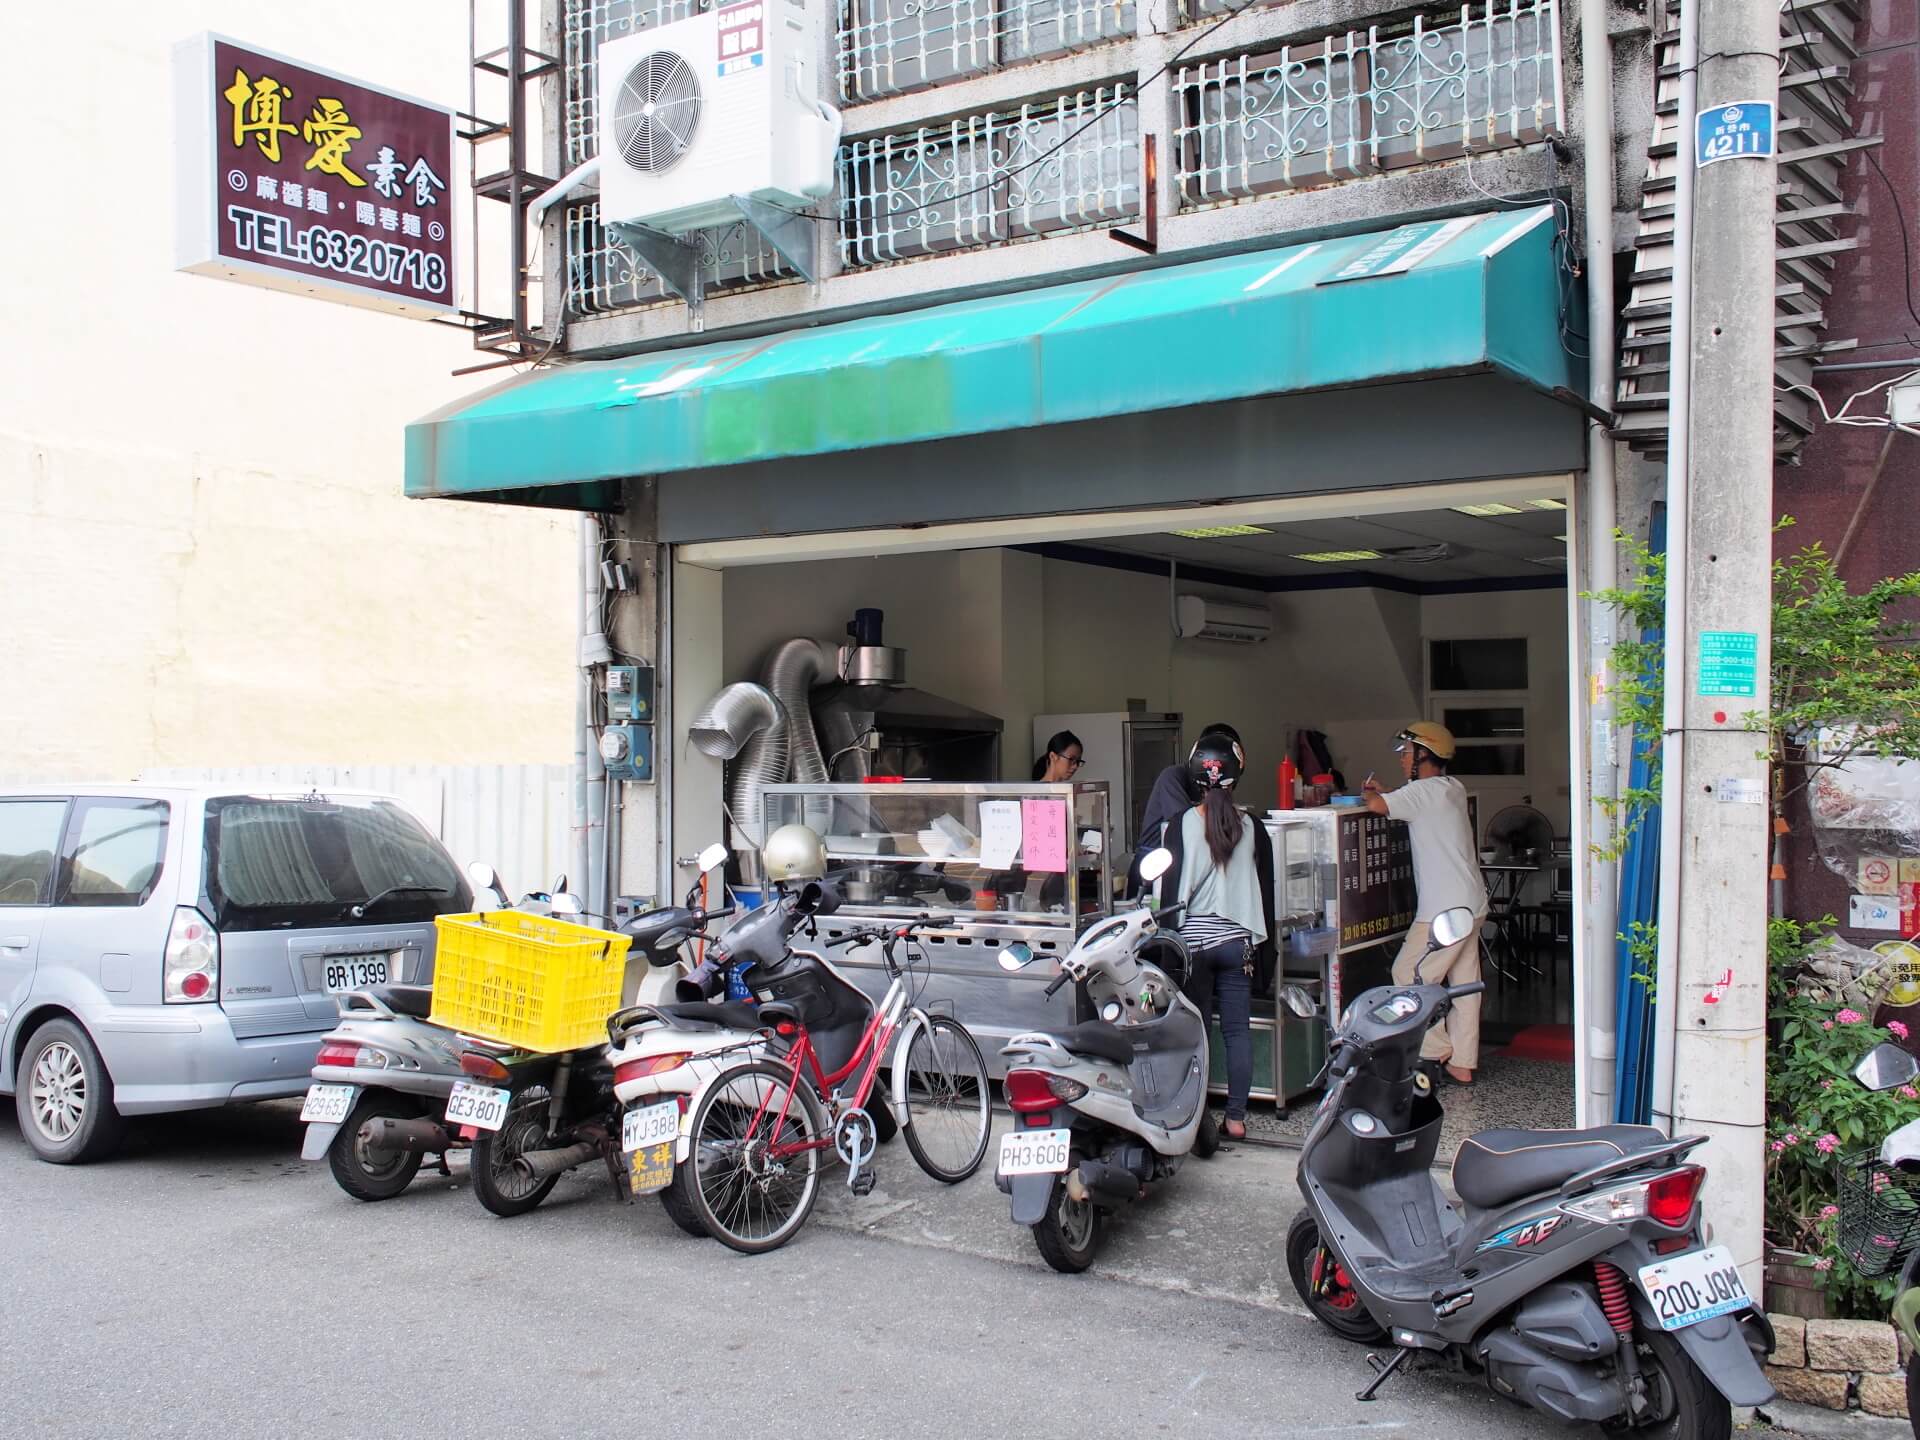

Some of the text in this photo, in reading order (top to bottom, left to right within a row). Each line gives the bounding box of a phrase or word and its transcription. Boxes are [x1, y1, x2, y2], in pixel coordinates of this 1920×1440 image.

[718, 4, 763, 30] SAMPO
[224, 68, 446, 207] 博愛 素食
[1704, 131, 1760, 158] 4211
[228, 204, 446, 294] TEL:6320718
